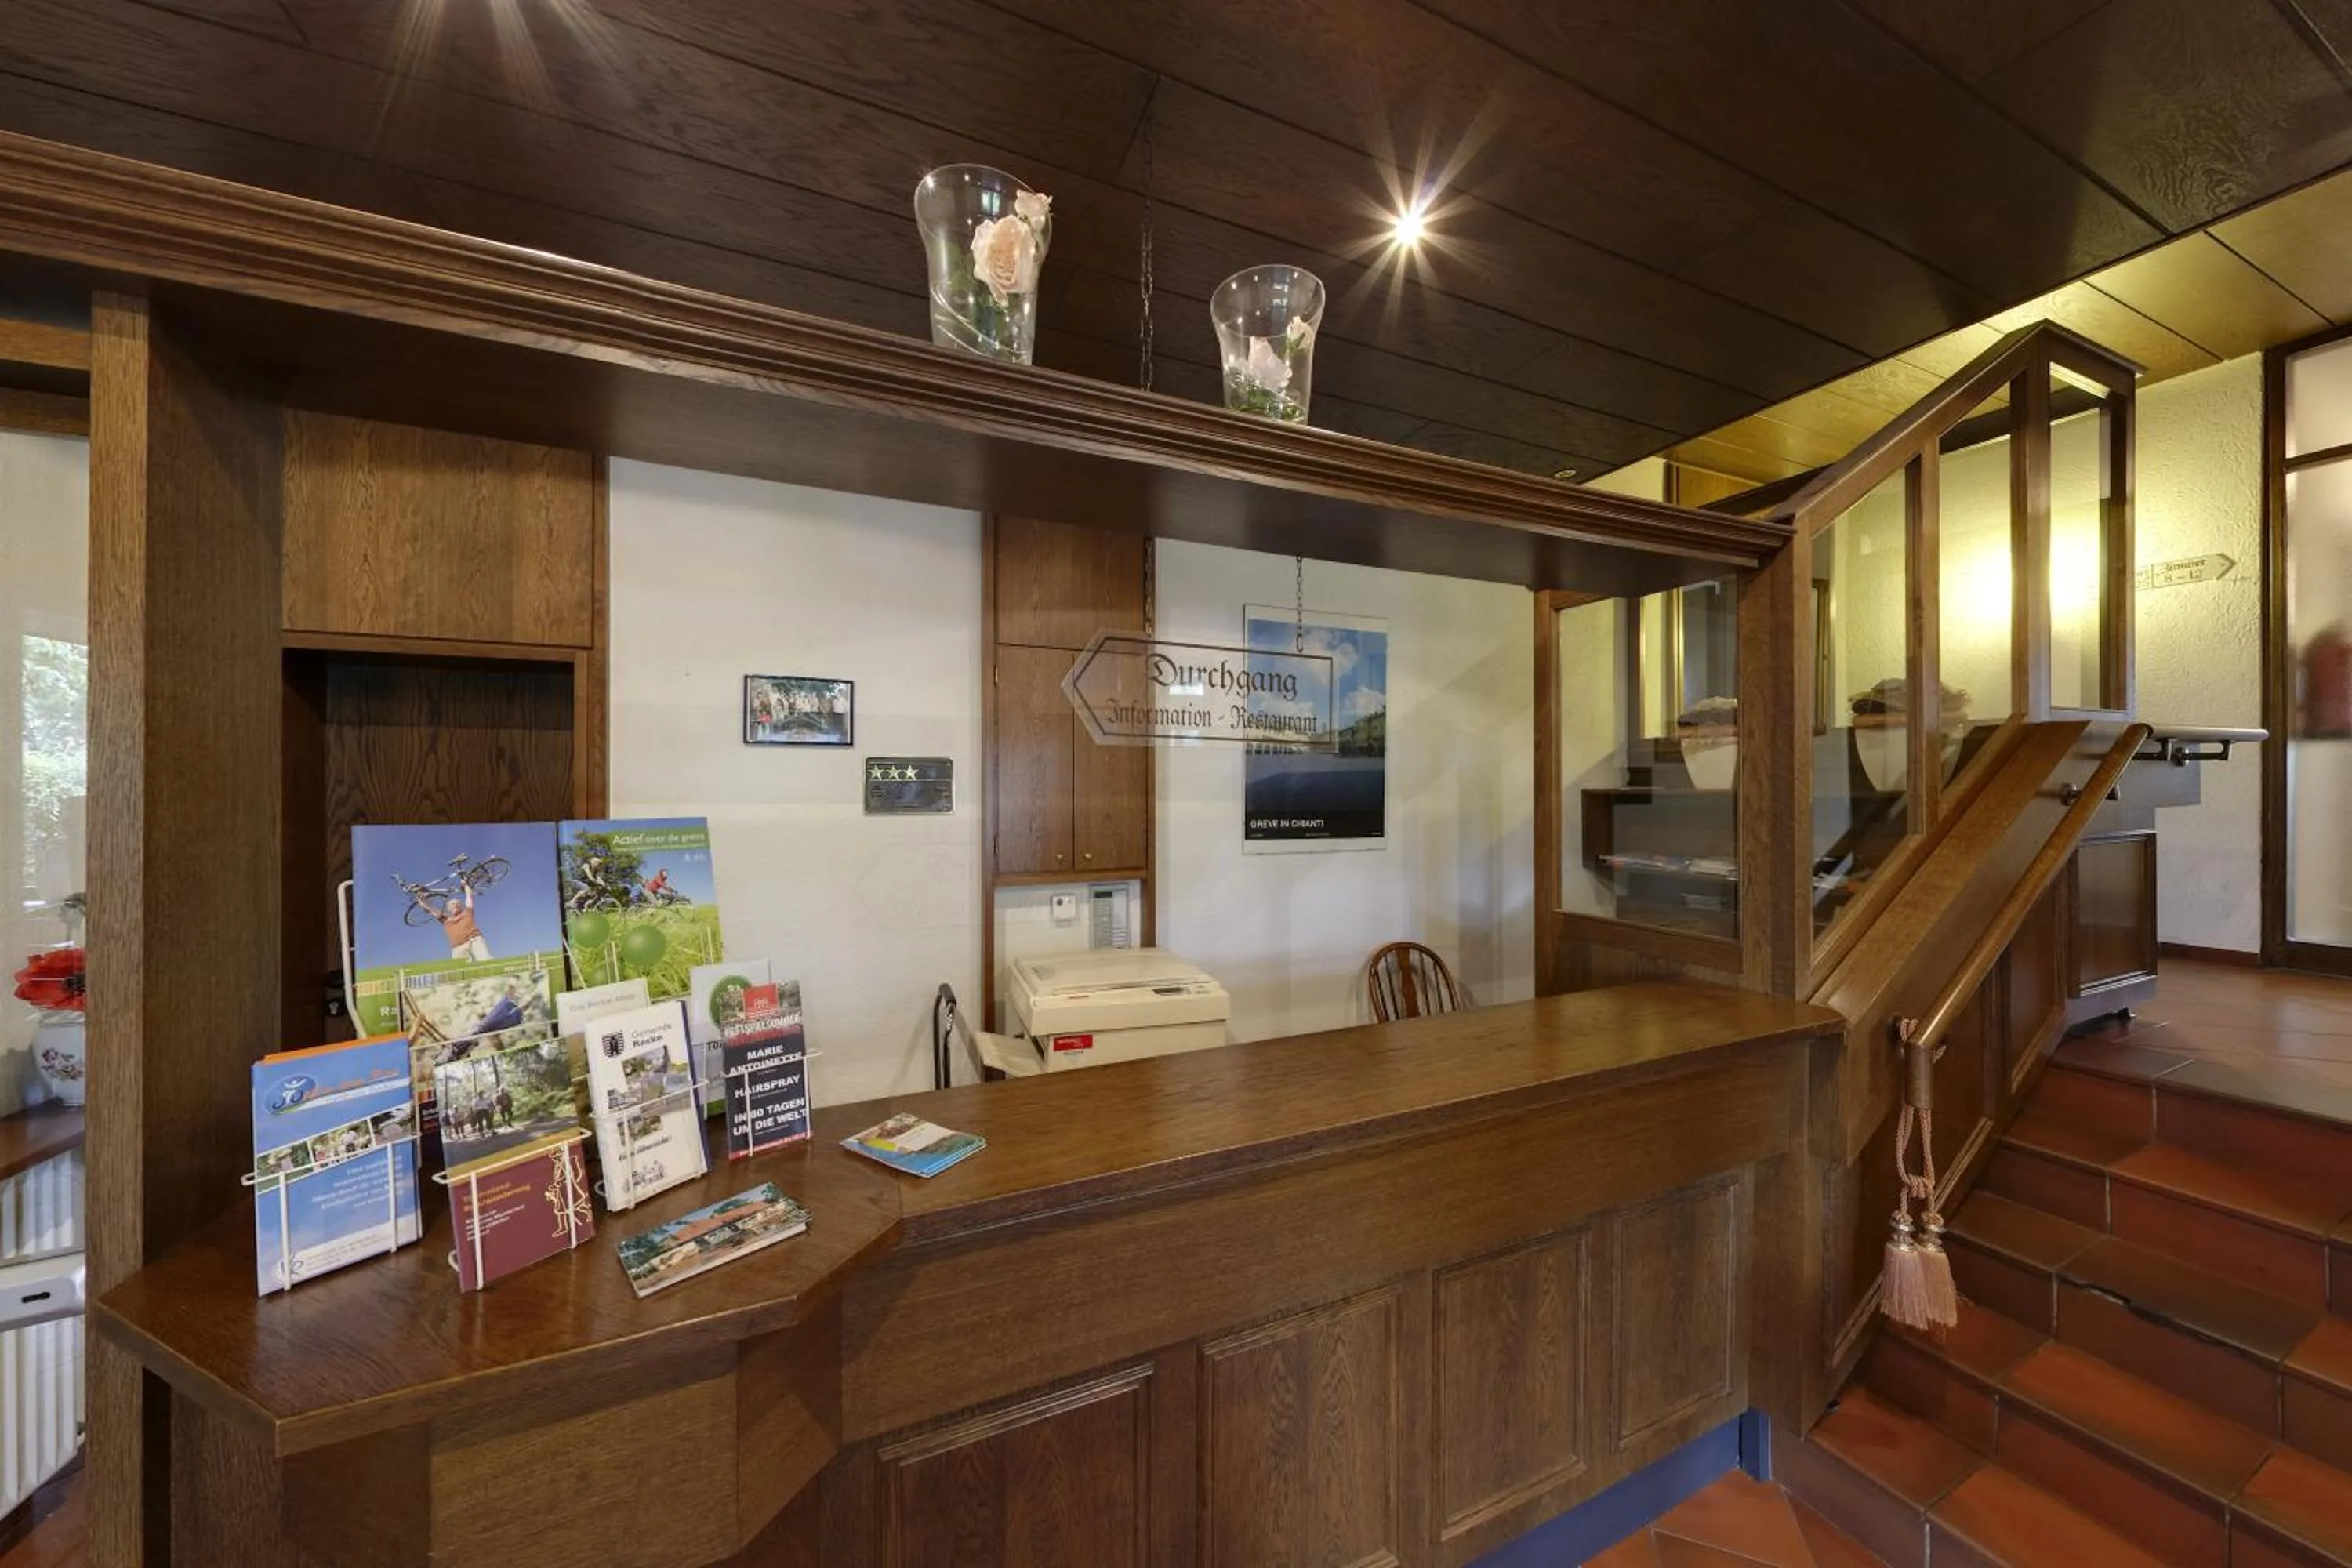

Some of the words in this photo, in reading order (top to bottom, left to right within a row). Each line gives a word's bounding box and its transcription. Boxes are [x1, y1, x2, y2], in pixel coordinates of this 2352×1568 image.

[1148, 652, 1298, 702] Durchgang
[1104, 697, 1212, 728] Information
[1229, 705, 1319, 734] Restaurant
[1250, 818, 1279, 829] GREVE
[1280, 818, 1290, 828] IN
[1291, 818, 1325, 828] CHIANTI
[613, 833, 644, 845] Actief
[729, 1051, 803, 1075] ANTOINETTE
[746, 1044, 784, 1061] MARIE
[734, 1074, 800, 1098] HAIRSPRAY
[766, 1097, 805, 1114] TAGEN
[755, 1116, 775, 1130] DIE
[775, 1108, 808, 1123] WELT
